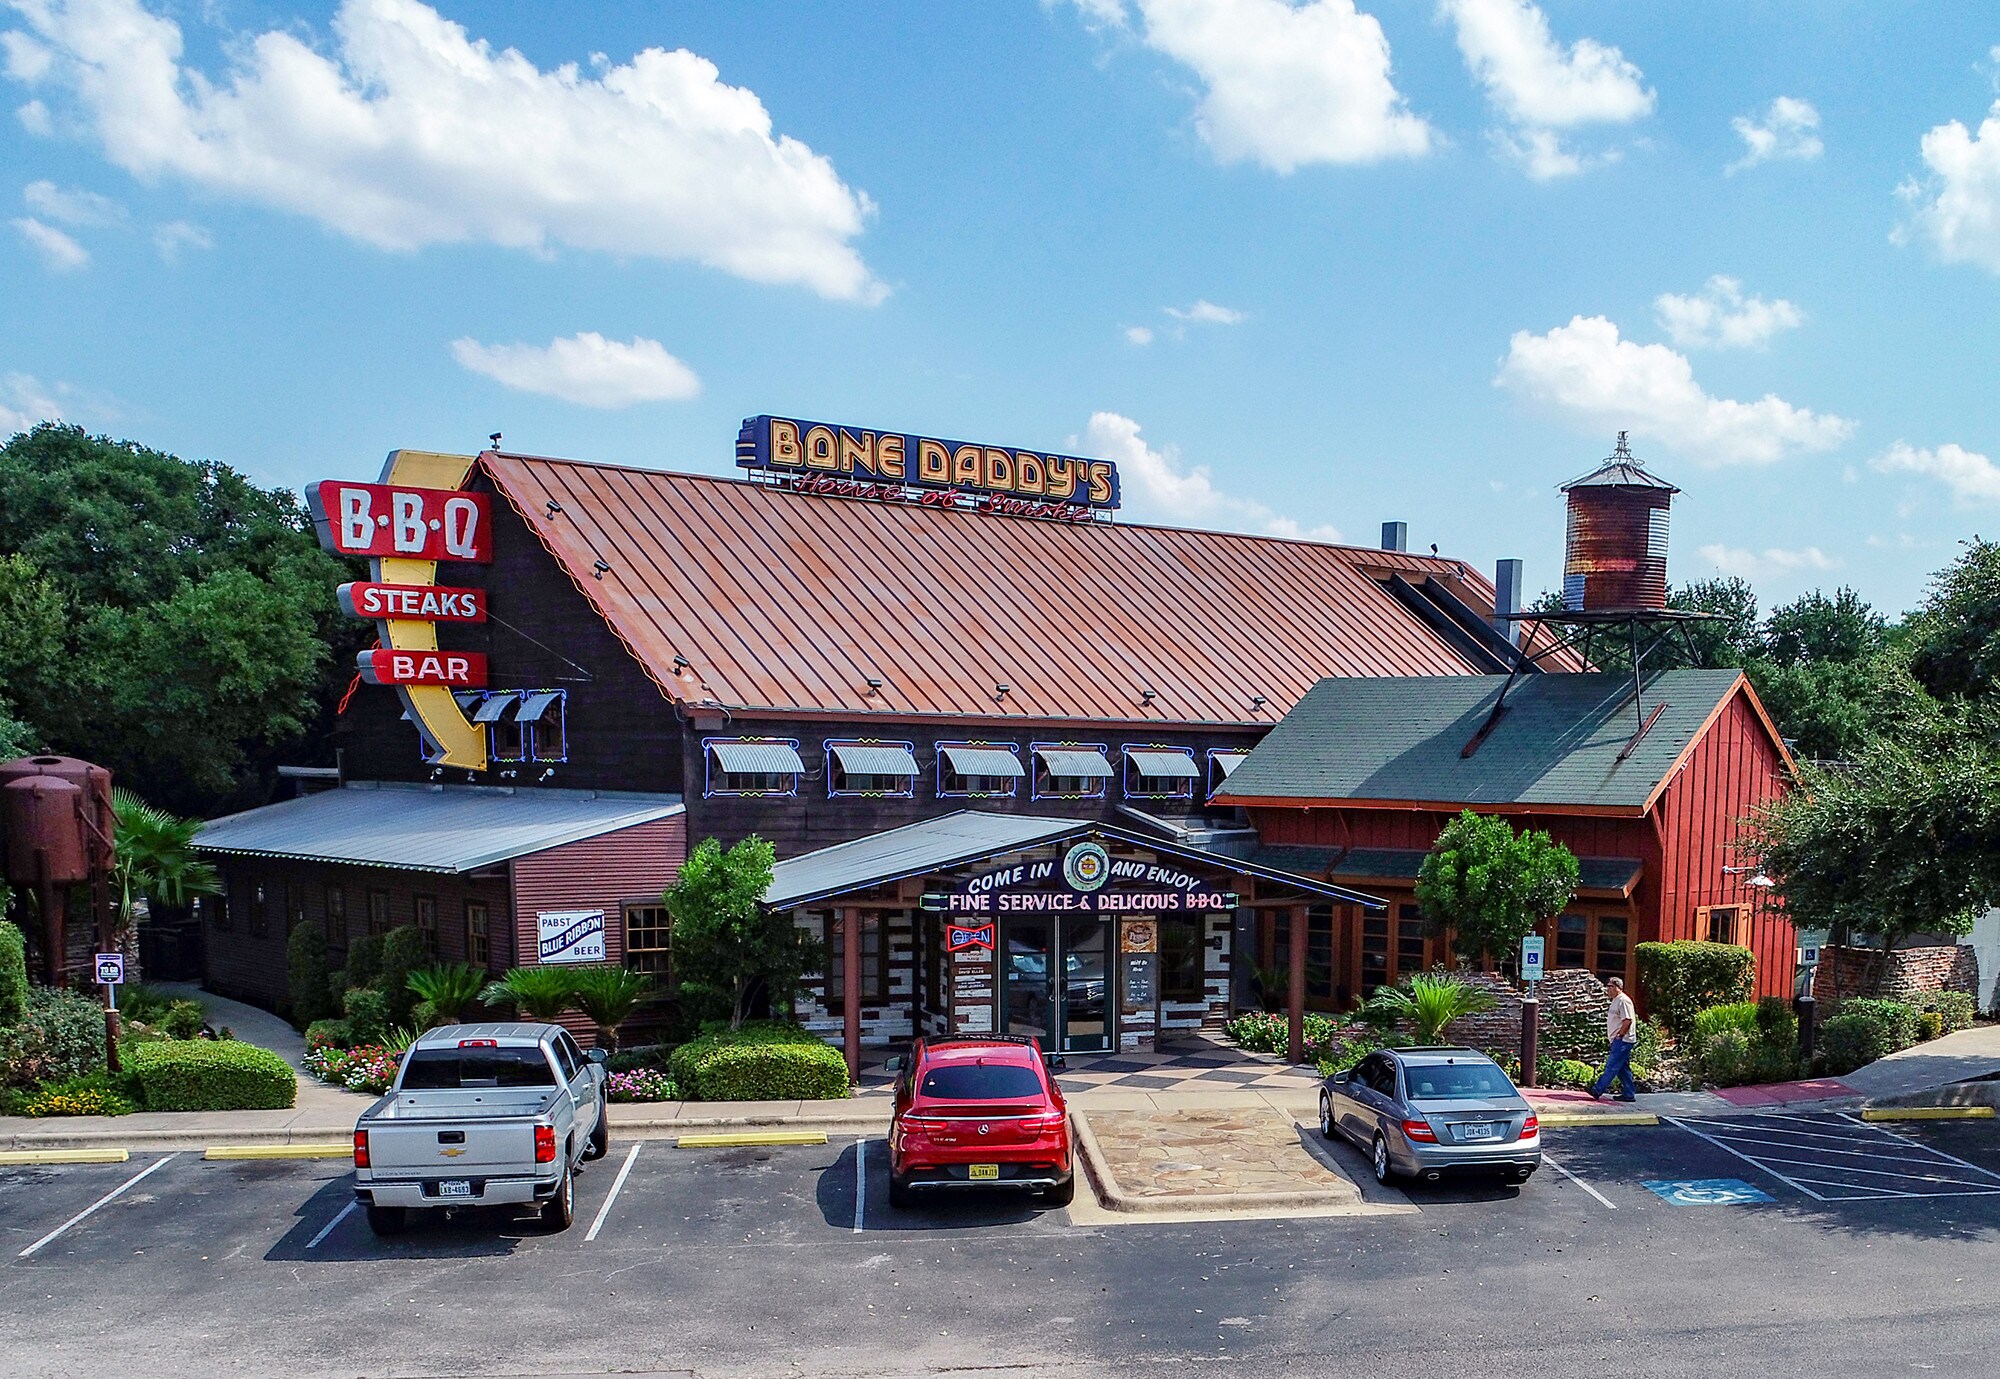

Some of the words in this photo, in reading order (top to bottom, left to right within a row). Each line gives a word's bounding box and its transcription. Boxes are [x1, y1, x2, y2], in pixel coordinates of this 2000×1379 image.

[770, 418, 906, 478] BONE
[919, 438, 1112, 503] DADDY'S
[793, 471, 905, 500] House
[921, 488, 963, 508] of
[979, 493, 1092, 520] Smoke
[363, 588, 478, 618] STEAKS
[392, 655, 470, 683] BAR
[967, 866, 1024, 895] COME
[1029, 862, 1054, 880] IN
[1110, 860, 1146, 879] AND
[1146, 866, 1201, 892] ENJOY
[949, 894, 990, 911] FINE
[998, 894, 1074, 911] SERVICE
[1079, 894, 1092, 911] &
[1097, 893, 1179, 910] DELICIOUS
[542, 917, 571, 928] PABST
[542, 936, 565, 955] BLUE
[565, 917, 601, 945] RIBBON
[951, 928, 991, 946] OPEN
[574, 946, 600, 956] BEER
